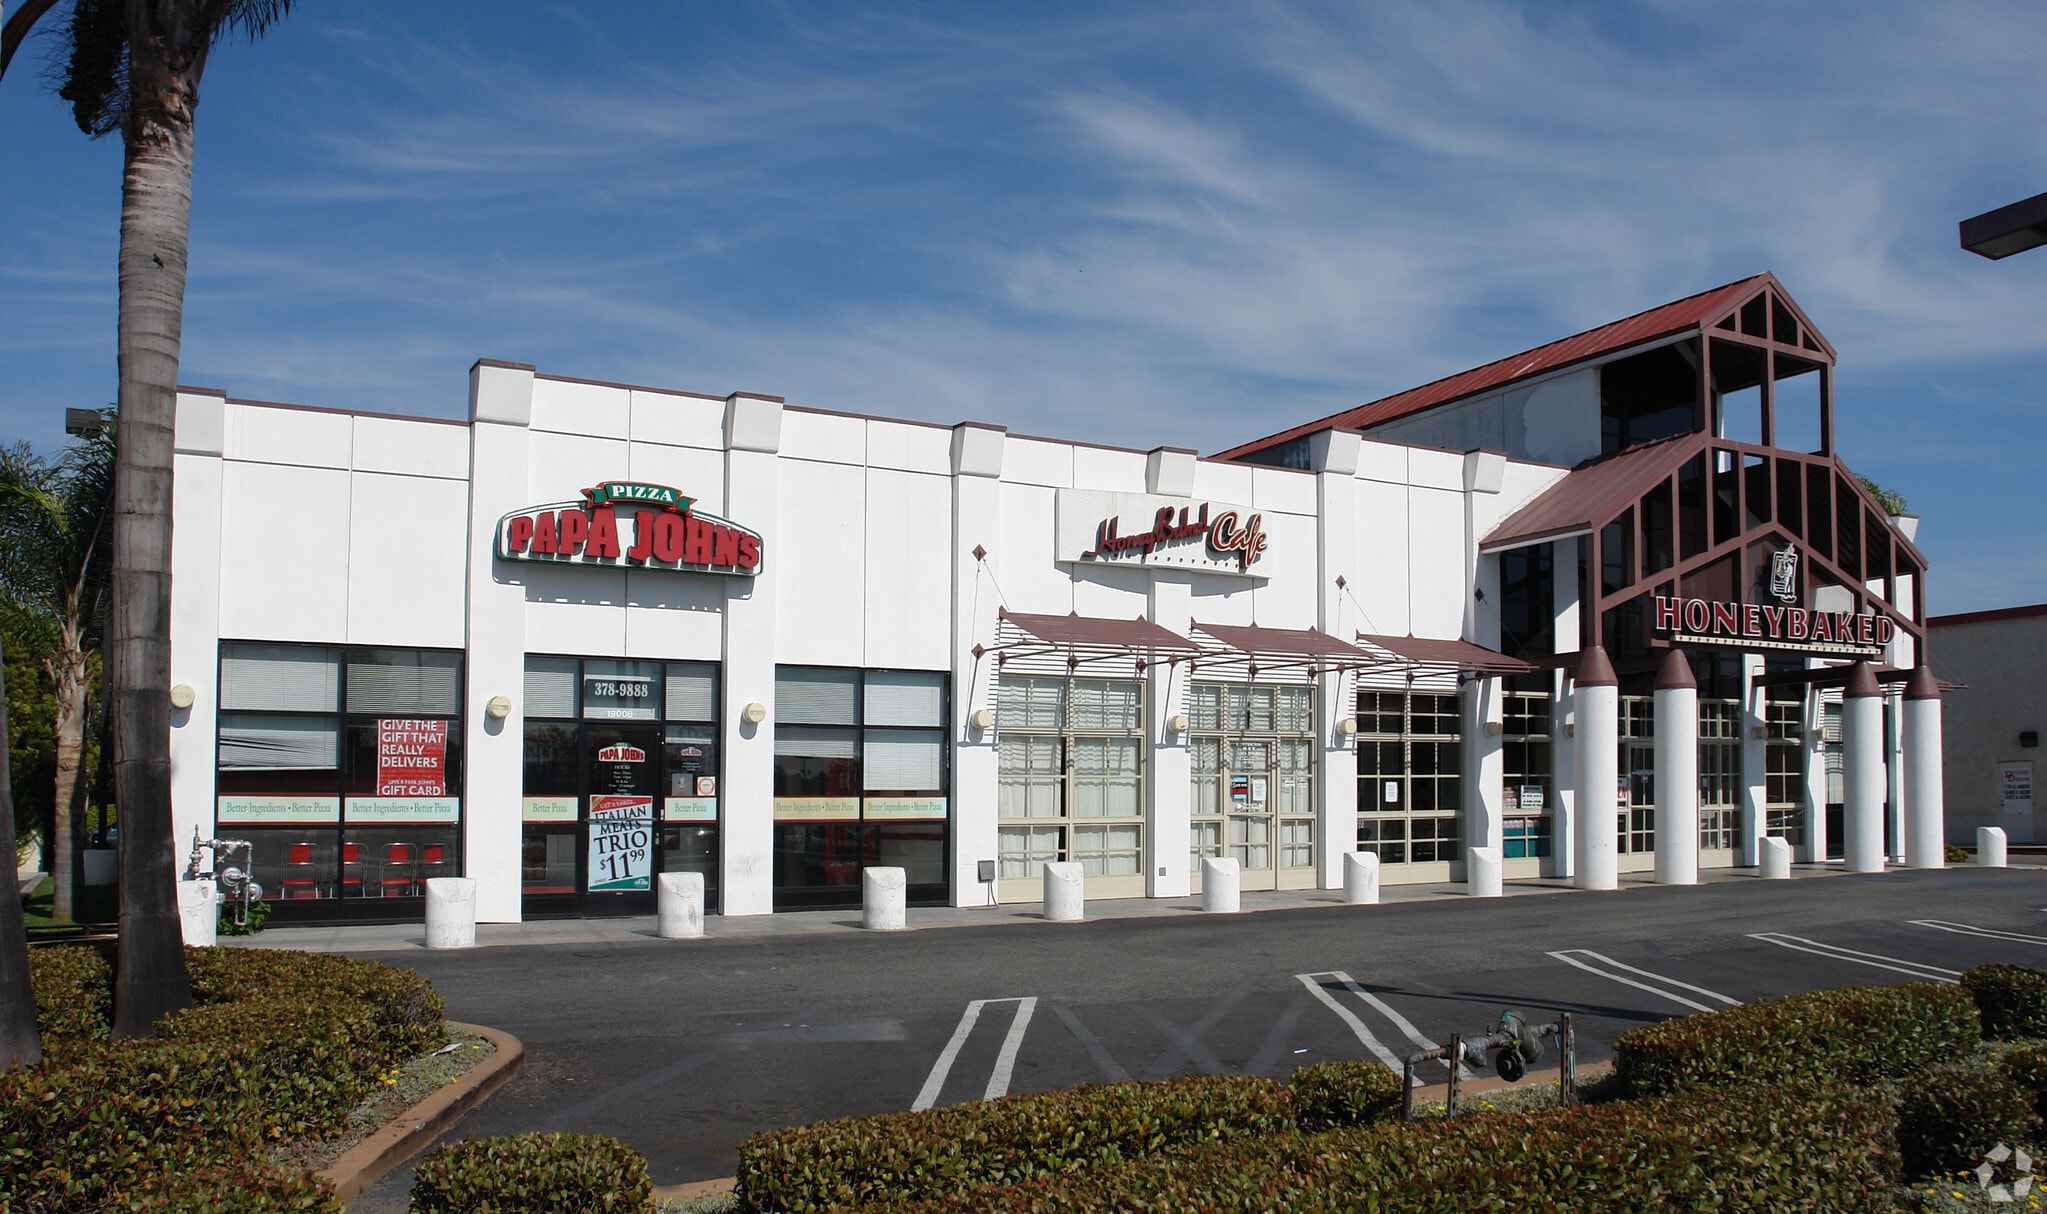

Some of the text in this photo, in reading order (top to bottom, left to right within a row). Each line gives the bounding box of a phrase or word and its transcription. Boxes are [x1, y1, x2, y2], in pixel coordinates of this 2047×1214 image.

[612, 484, 673, 503] PIZZA
[510, 508, 760, 569] PAPA JOHN'S
[1211, 511, 1269, 567] Cafe
[1655, 596, 1895, 646] HONEYBAKED
[594, 682, 648, 697] 378-9888
[606, 710, 633, 718] 19008
[382, 719, 437, 731] GIVE THE
[382, 732, 444, 744] GIFT THAT
[381, 744, 425, 756] REALLY
[381, 756, 438, 768] DELIVERS
[381, 785, 441, 796] GIFT CARD
[226, 802, 331, 817] Better Ingredients Better Pizza
[352, 802, 451, 816] Better Ingredients Better Pizza
[532, 802, 567, 812] Better Pizza
[674, 803, 707, 812] Better Pizza
[594, 806, 647, 823] ITALIAN
[600, 820, 642, 835] MEATS
[593, 830, 648, 854] TRIO
